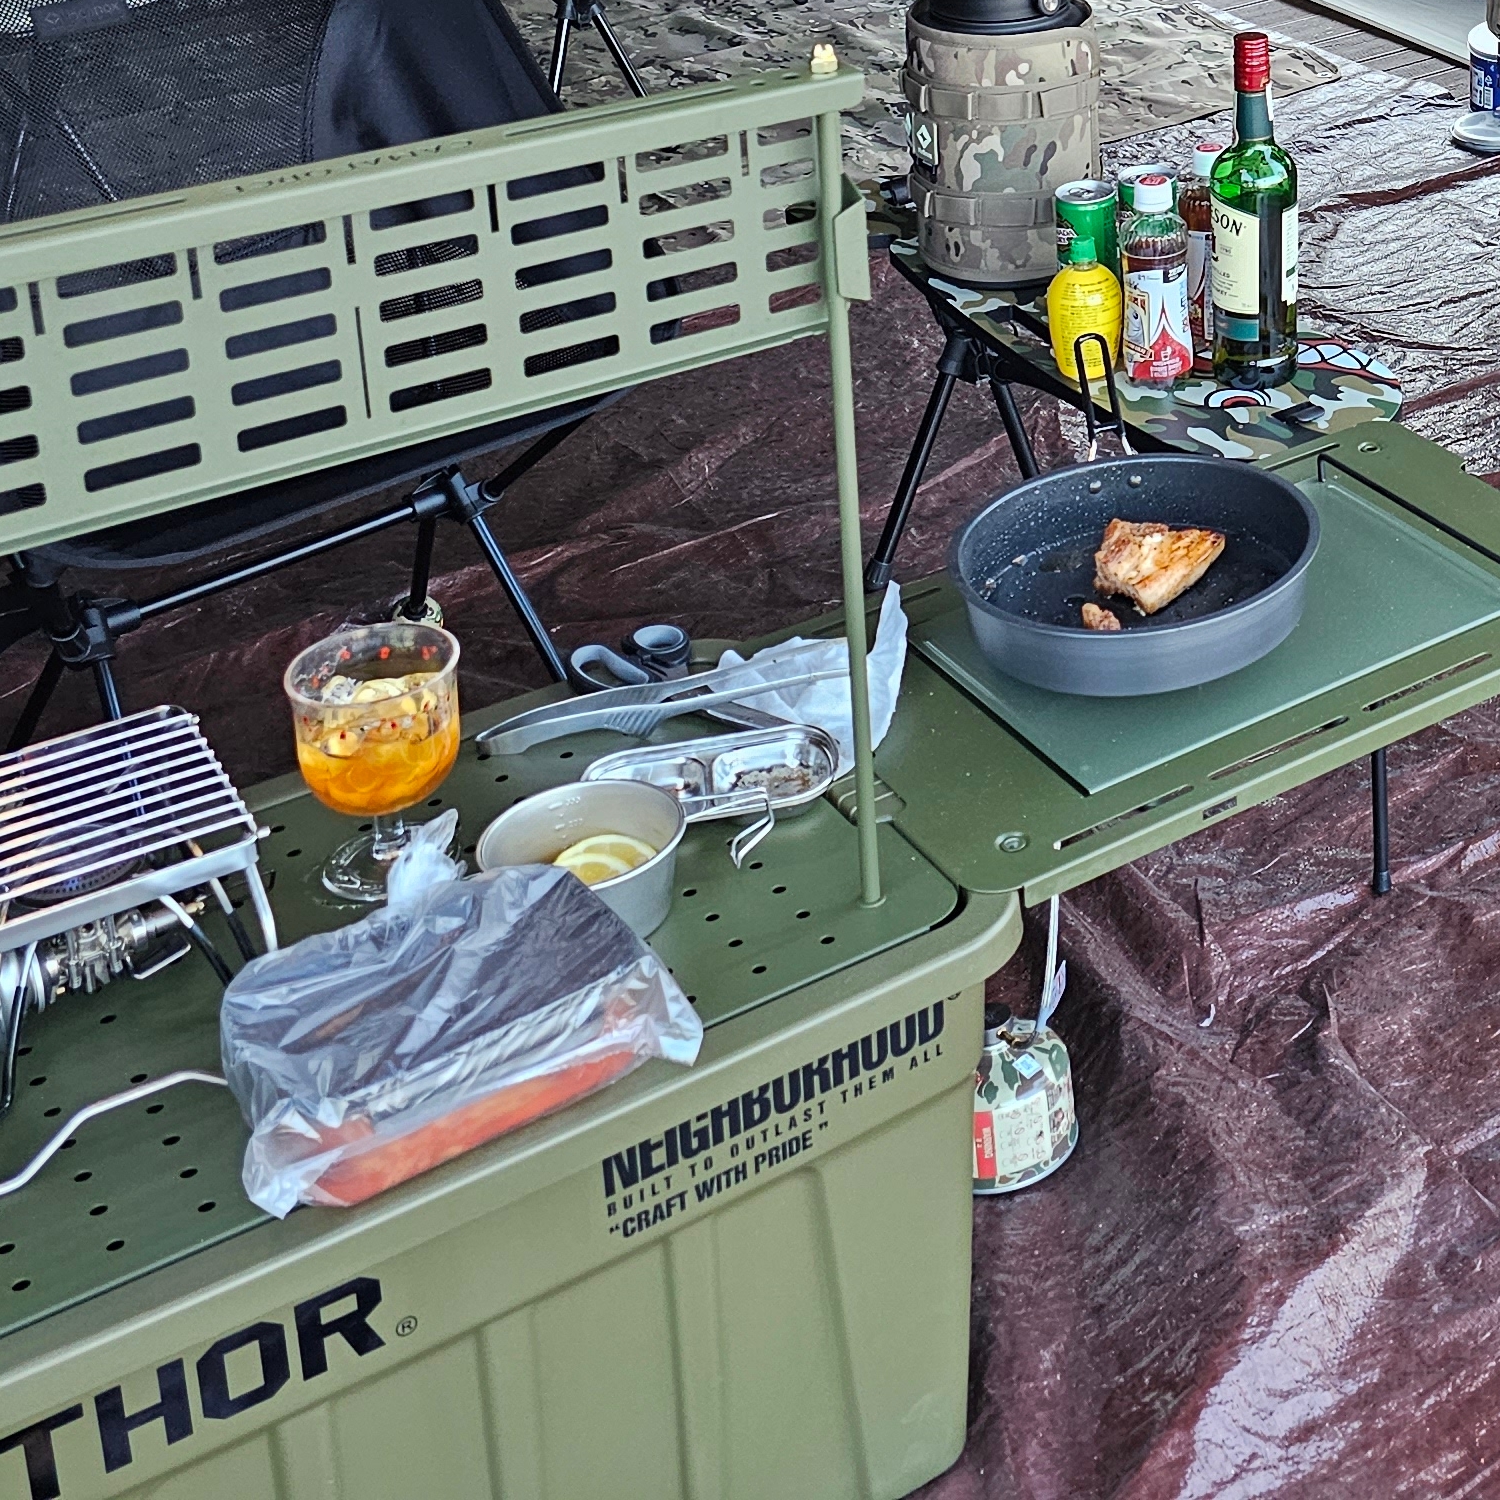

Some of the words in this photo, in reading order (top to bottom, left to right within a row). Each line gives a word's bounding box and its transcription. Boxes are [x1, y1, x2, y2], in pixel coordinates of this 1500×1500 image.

[601, 999, 946, 1198] NEIGHBORHOOD
[607, 1175, 674, 1218] BUILT
[689, 1156, 714, 1179] TO
[729, 1100, 828, 1158] OUTLAST
[840, 1065, 896, 1105] THEM
[909, 1042, 945, 1071] ALL
[695, 1160, 749, 1203] WITH
[0, 1276, 387, 1500] THOR
